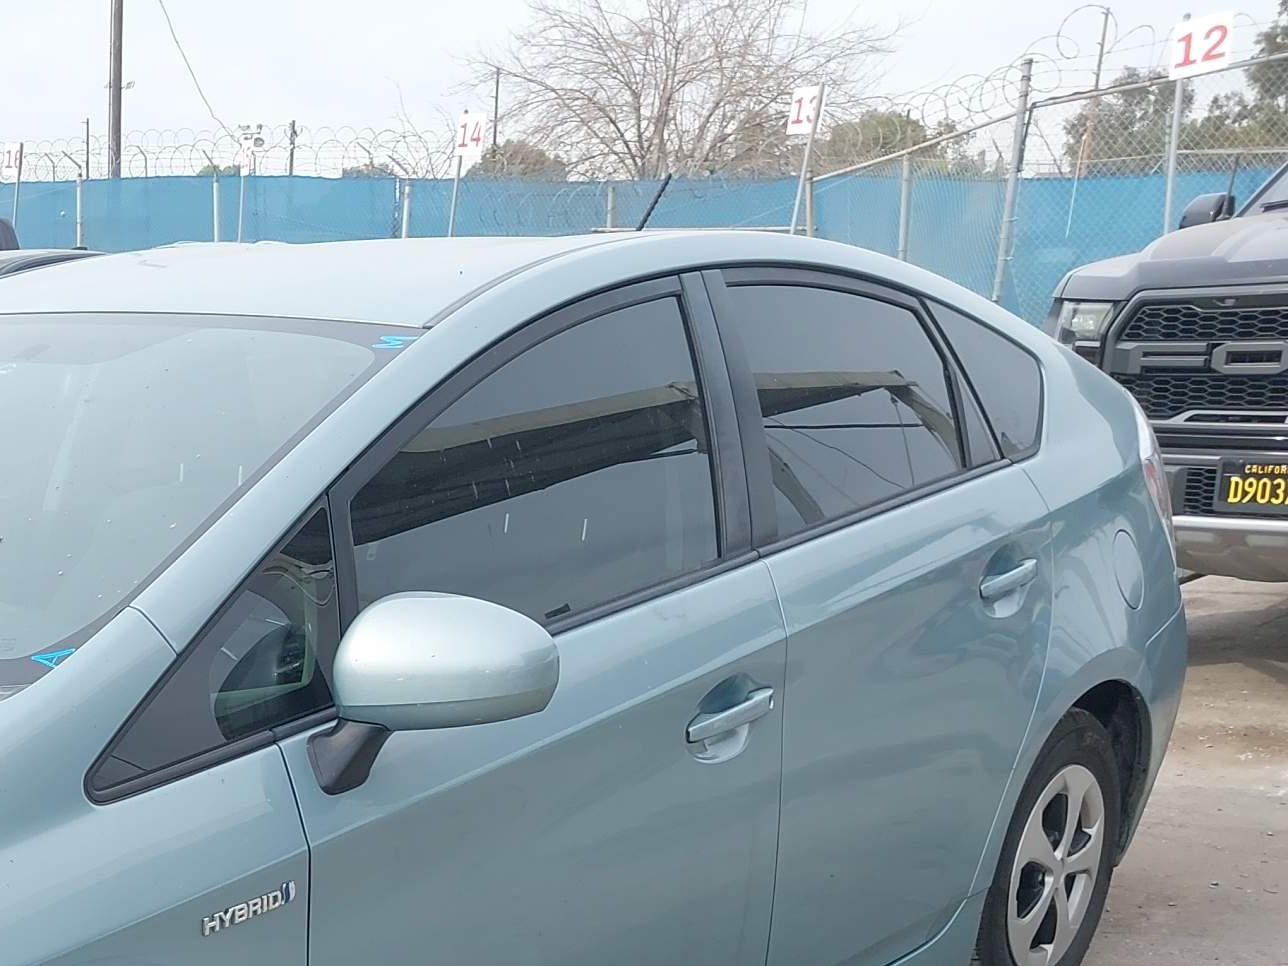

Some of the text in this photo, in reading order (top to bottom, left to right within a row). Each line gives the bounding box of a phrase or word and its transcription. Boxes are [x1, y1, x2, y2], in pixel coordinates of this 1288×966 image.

[1174, 25, 1228, 69] 12
[458, 120, 482, 148] 14
[1227, 476, 1288, 505] D903
[202, 890, 282, 937] HYBRID
